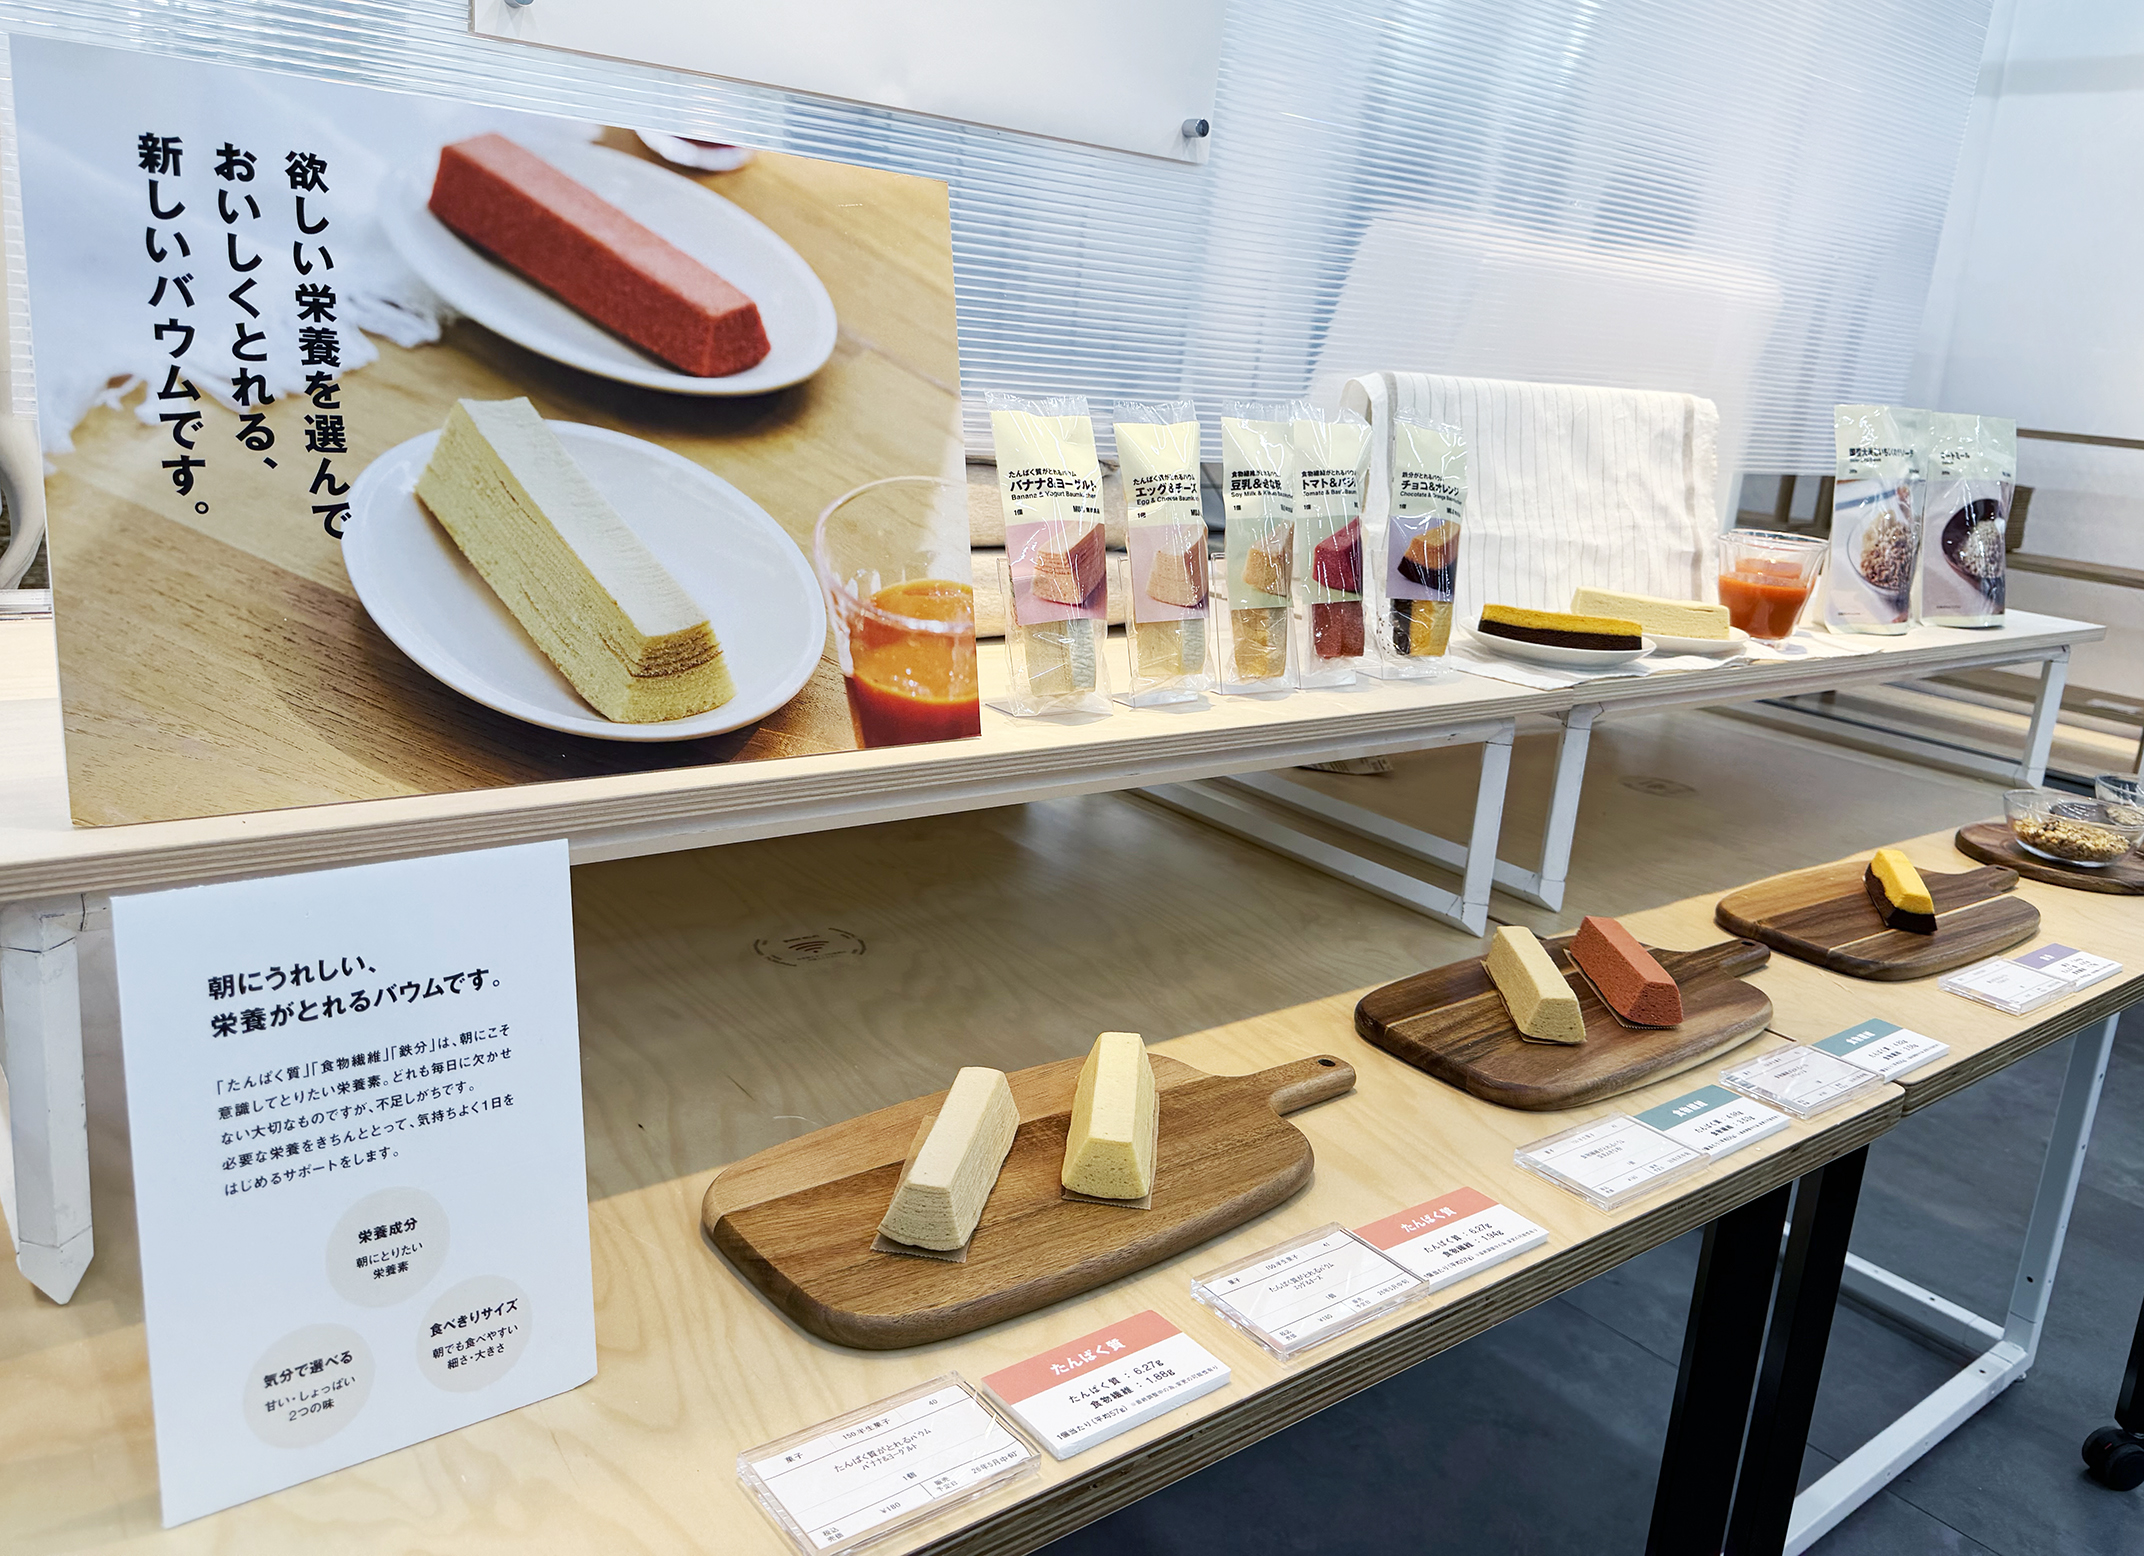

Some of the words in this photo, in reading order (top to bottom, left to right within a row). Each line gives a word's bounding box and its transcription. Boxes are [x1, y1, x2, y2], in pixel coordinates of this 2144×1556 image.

[138, 132, 209, 515] 新しいバウムです。
[214, 142, 279, 470] おいしくとれる、
[285, 151, 351, 540] 欲しい栄養を選んで
[208, 956, 377, 1001] 朝にうれしい、
[211, 968, 501, 1038] 栄養がとれるバウムです。
[217, 1023, 511, 1096] 「たんぱく質」「食物繊維」「鉄分」は、朝にこそ
[218, 1047, 513, 1120] 意識してとりたい栄養素。どれも毎日に欠かせ
[221, 1081, 476, 1145] ない大切なものですが、不足しがちです。
[222, 1093, 514, 1171] 必要な栄養をきちんととって、気持ちよく1日を
[224, 1147, 400, 1196] はじめるサポートをします。
[358, 1217, 418, 1244] 栄養成分
[356, 1242, 423, 1269] 朝にとりたい
[373, 1261, 409, 1280] 栄養素
[429, 1298, 519, 1337] 食べきりサイズ
[432, 1324, 518, 1359] 朝でも食べやすい
[447, 1343, 505, 1370] 細さ・大きさ
[1050, 1338, 1126, 1376] たんぱく質
[263, 1350, 353, 1388] 気分で選べる
[265, 1375, 356, 1413] 甘い・しょっぱい
[289, 1398, 335, 1422] 2つの味
[928, 1398, 938, 1406] 40
[902, 1471, 917, 1482] 1個
[880, 1501, 901, 1515] ¥180
